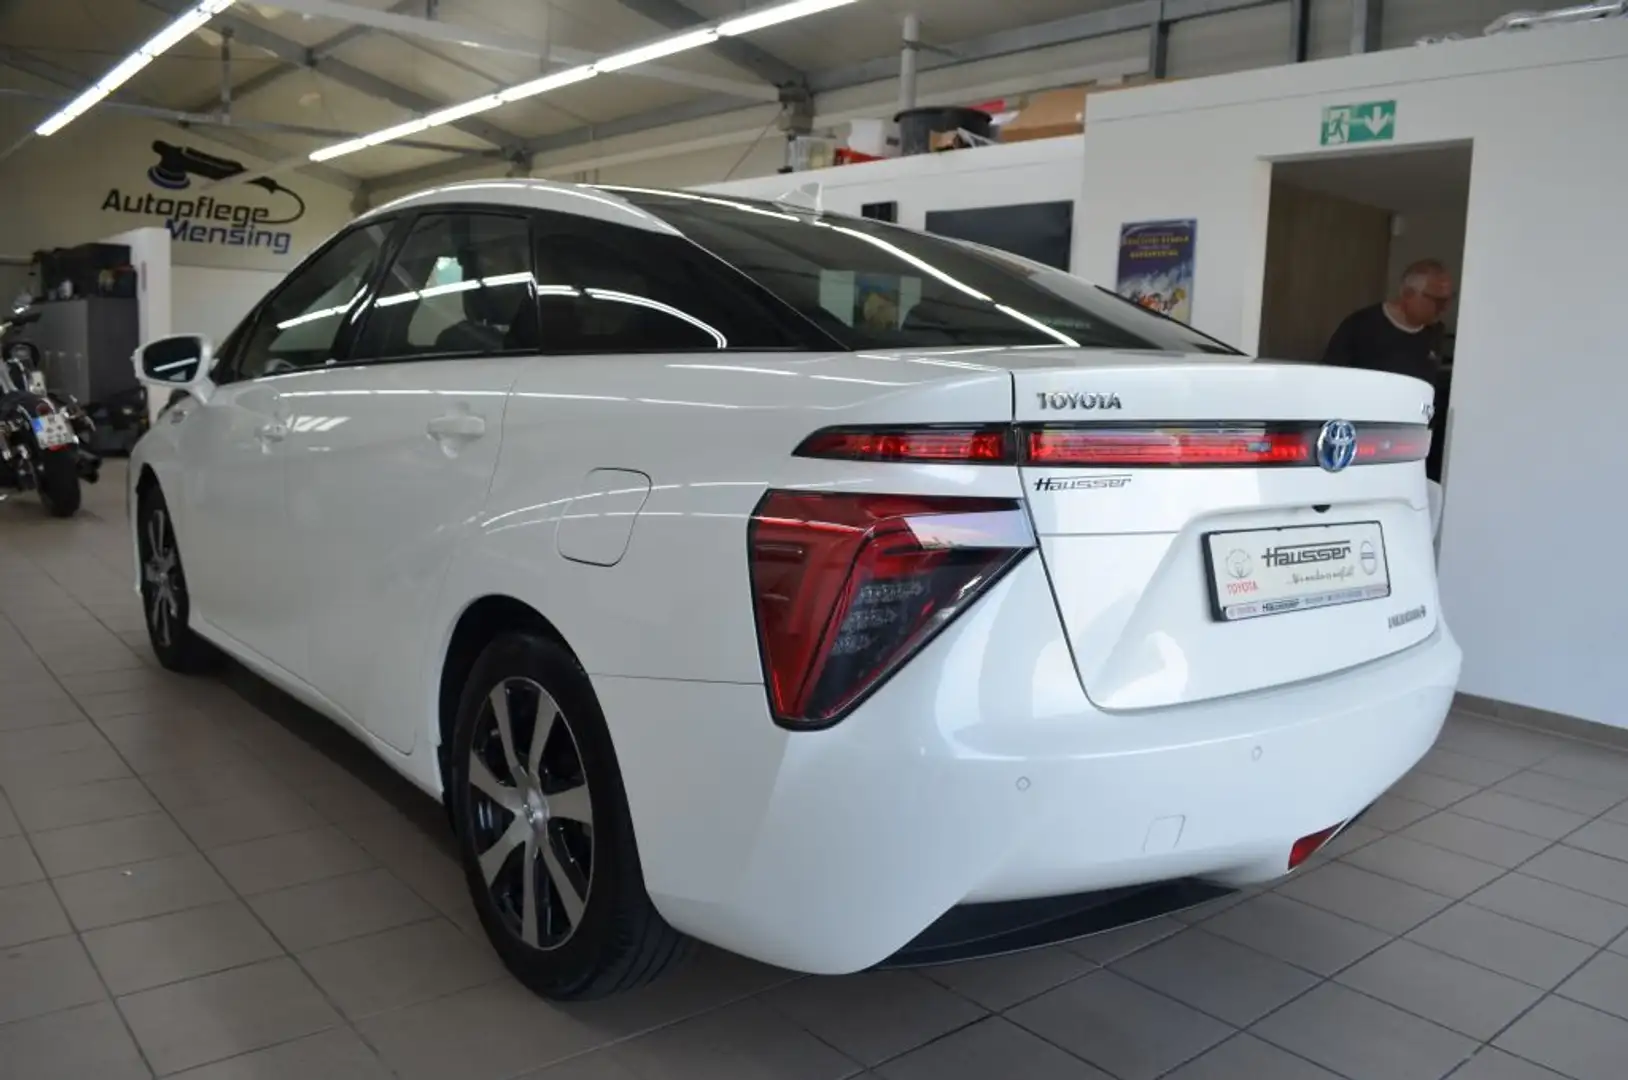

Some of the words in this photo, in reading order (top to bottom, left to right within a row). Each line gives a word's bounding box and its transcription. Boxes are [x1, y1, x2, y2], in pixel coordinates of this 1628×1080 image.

[101, 188, 269, 228] Autopflege
[165, 219, 291, 254] Mensing
[1036, 392, 1122, 410] TOYOTA
[1034, 474, 1132, 491] Hausser
[1261, 540, 1352, 567] Hausser
[1227, 581, 1259, 596] TOYOTA
